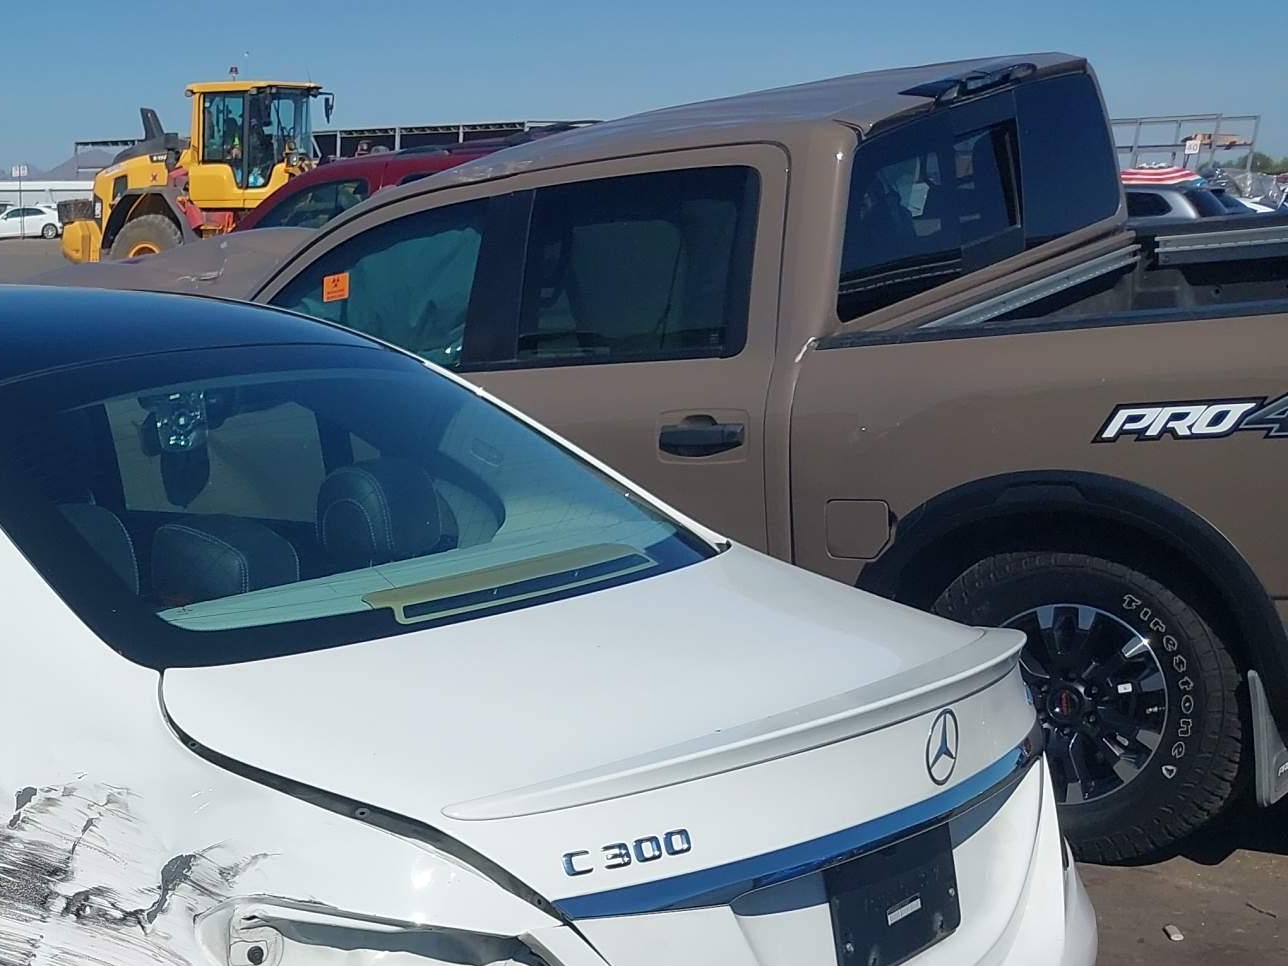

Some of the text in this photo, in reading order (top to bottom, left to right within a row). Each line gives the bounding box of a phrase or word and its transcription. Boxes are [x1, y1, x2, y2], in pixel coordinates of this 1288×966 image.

[1123, 594, 1194, 758] Firestone
[561, 828, 692, 876] C 300
